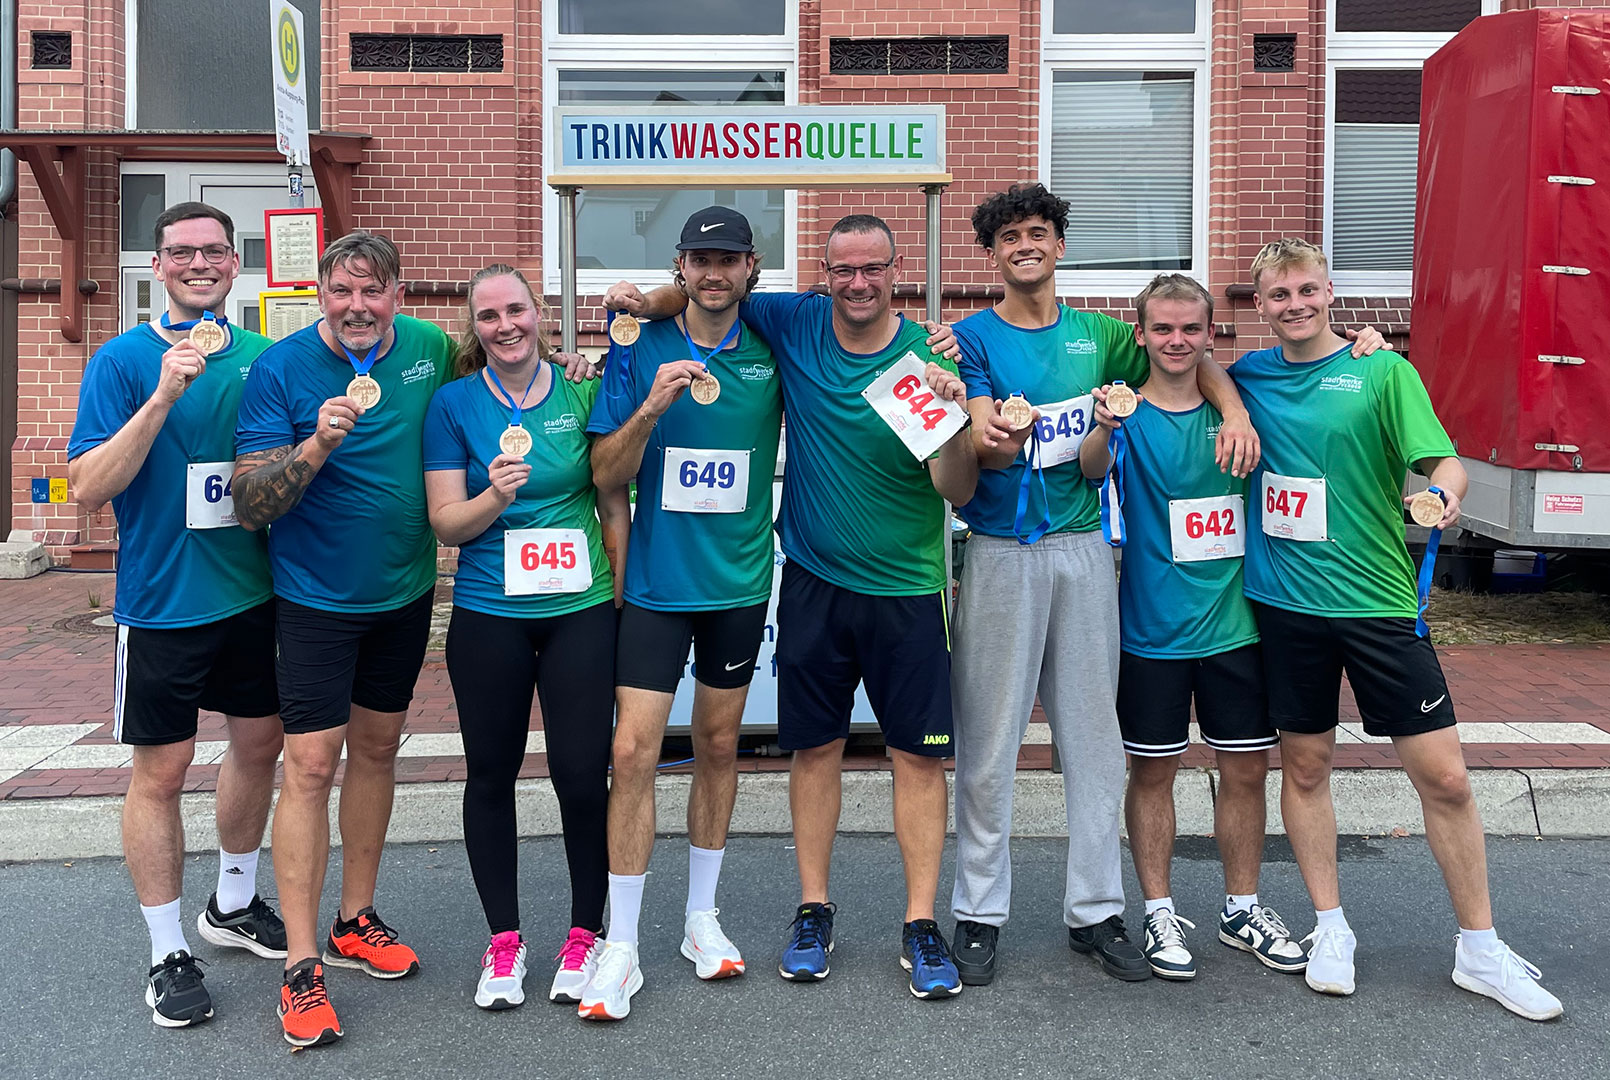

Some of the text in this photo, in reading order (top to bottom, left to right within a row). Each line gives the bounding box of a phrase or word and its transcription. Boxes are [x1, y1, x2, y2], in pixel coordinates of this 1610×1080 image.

[570, 122, 924, 160] TRINKWASSERQUELLE
[893, 374, 947, 432] 644
[1036, 408, 1086, 443] 643
[679, 460, 736, 489] 649
[1266, 486, 1308, 518] 647
[1185, 508, 1237, 539] 642
[520, 542, 577, 572] 645
[923, 734, 950, 745] JAKO
